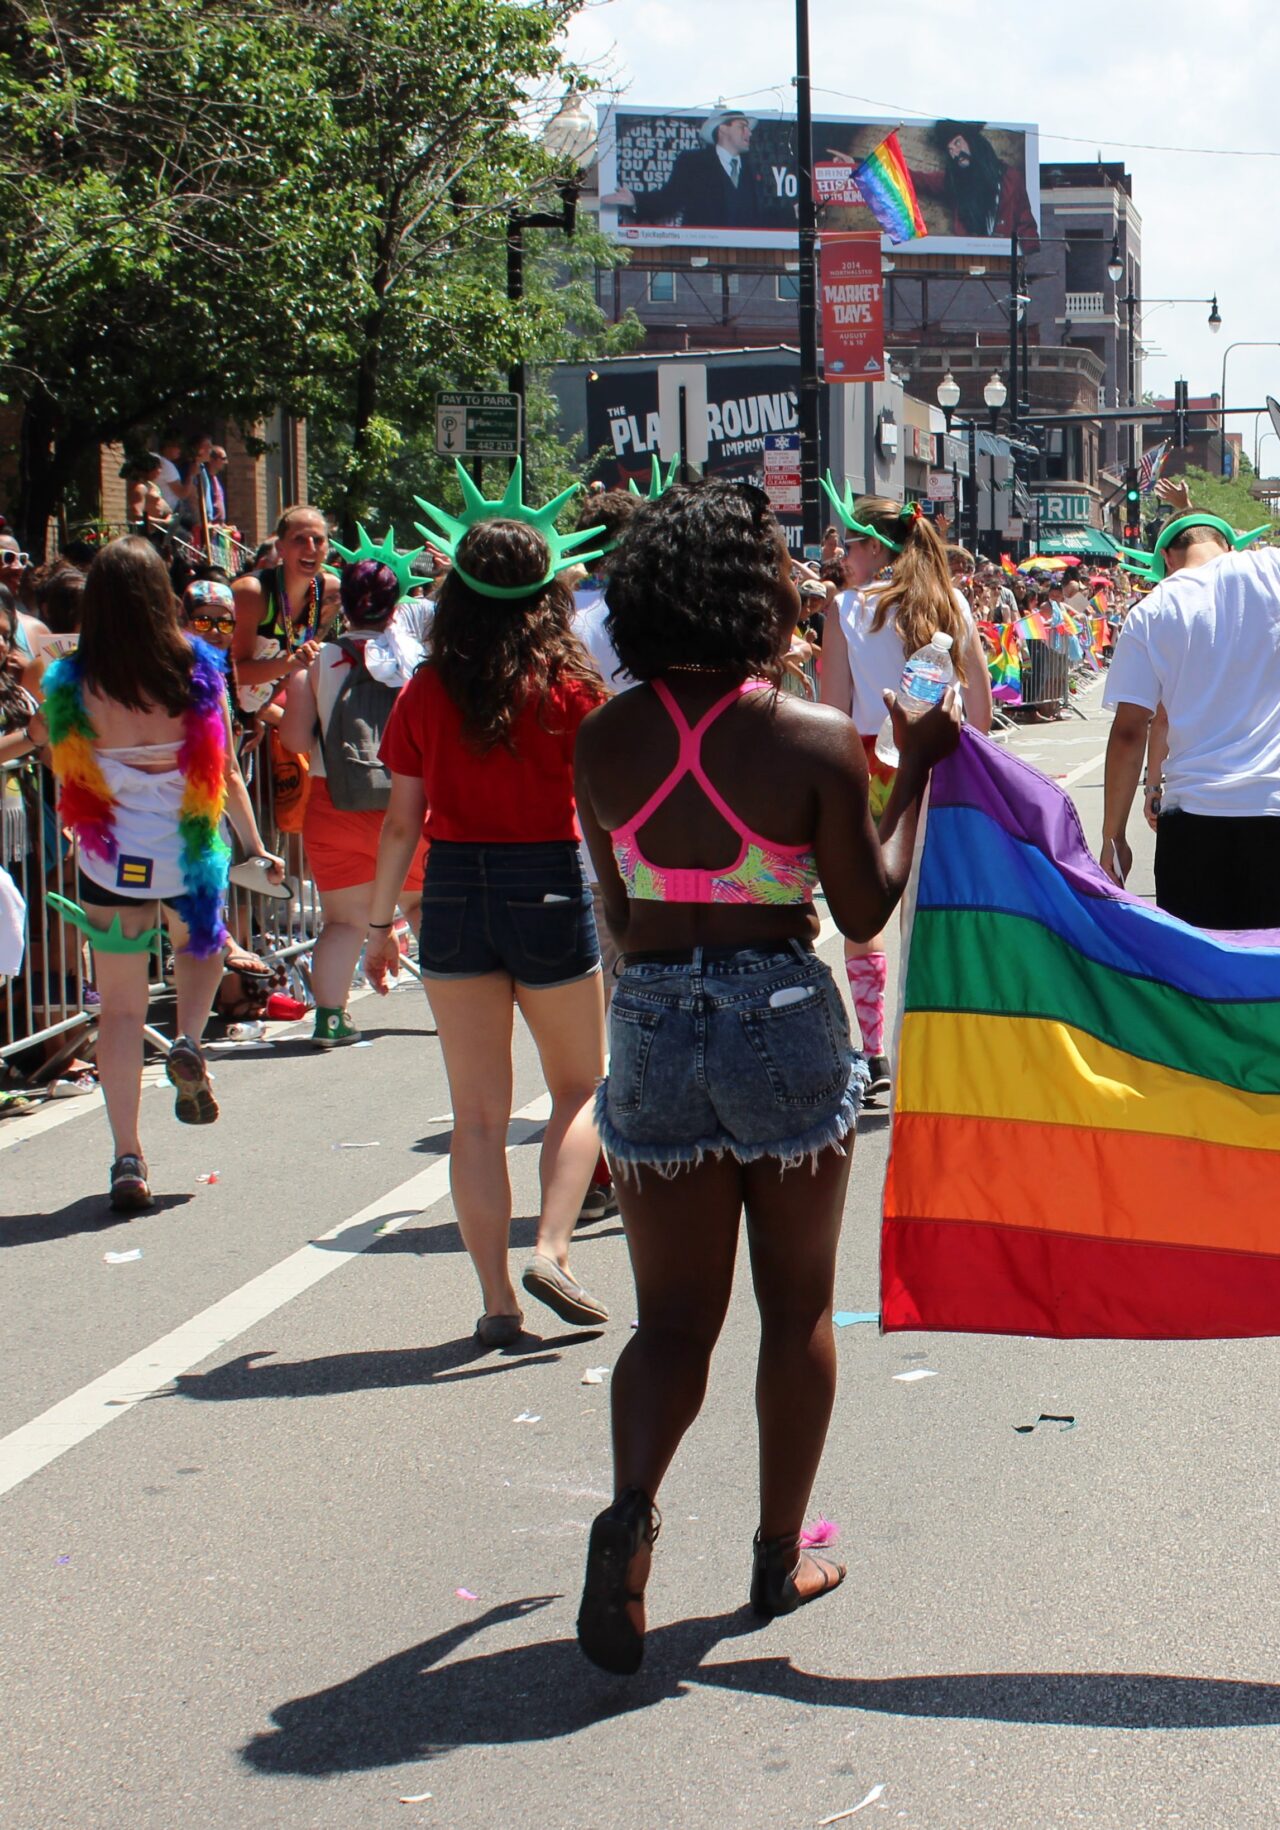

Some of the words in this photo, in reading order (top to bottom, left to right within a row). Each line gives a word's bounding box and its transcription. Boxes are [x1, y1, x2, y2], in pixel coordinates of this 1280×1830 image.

[636, 137, 666, 149] GET
[841, 261, 861, 270] 2014
[823, 283, 881, 304] MARKET
[832, 304, 873, 325] DAYS
[839, 332, 868, 340] AUGUST
[442, 395, 463, 405] PAY
[465, 395, 480, 405] TO
[483, 396, 513, 406] PARK
[606, 405, 627, 418] THE
